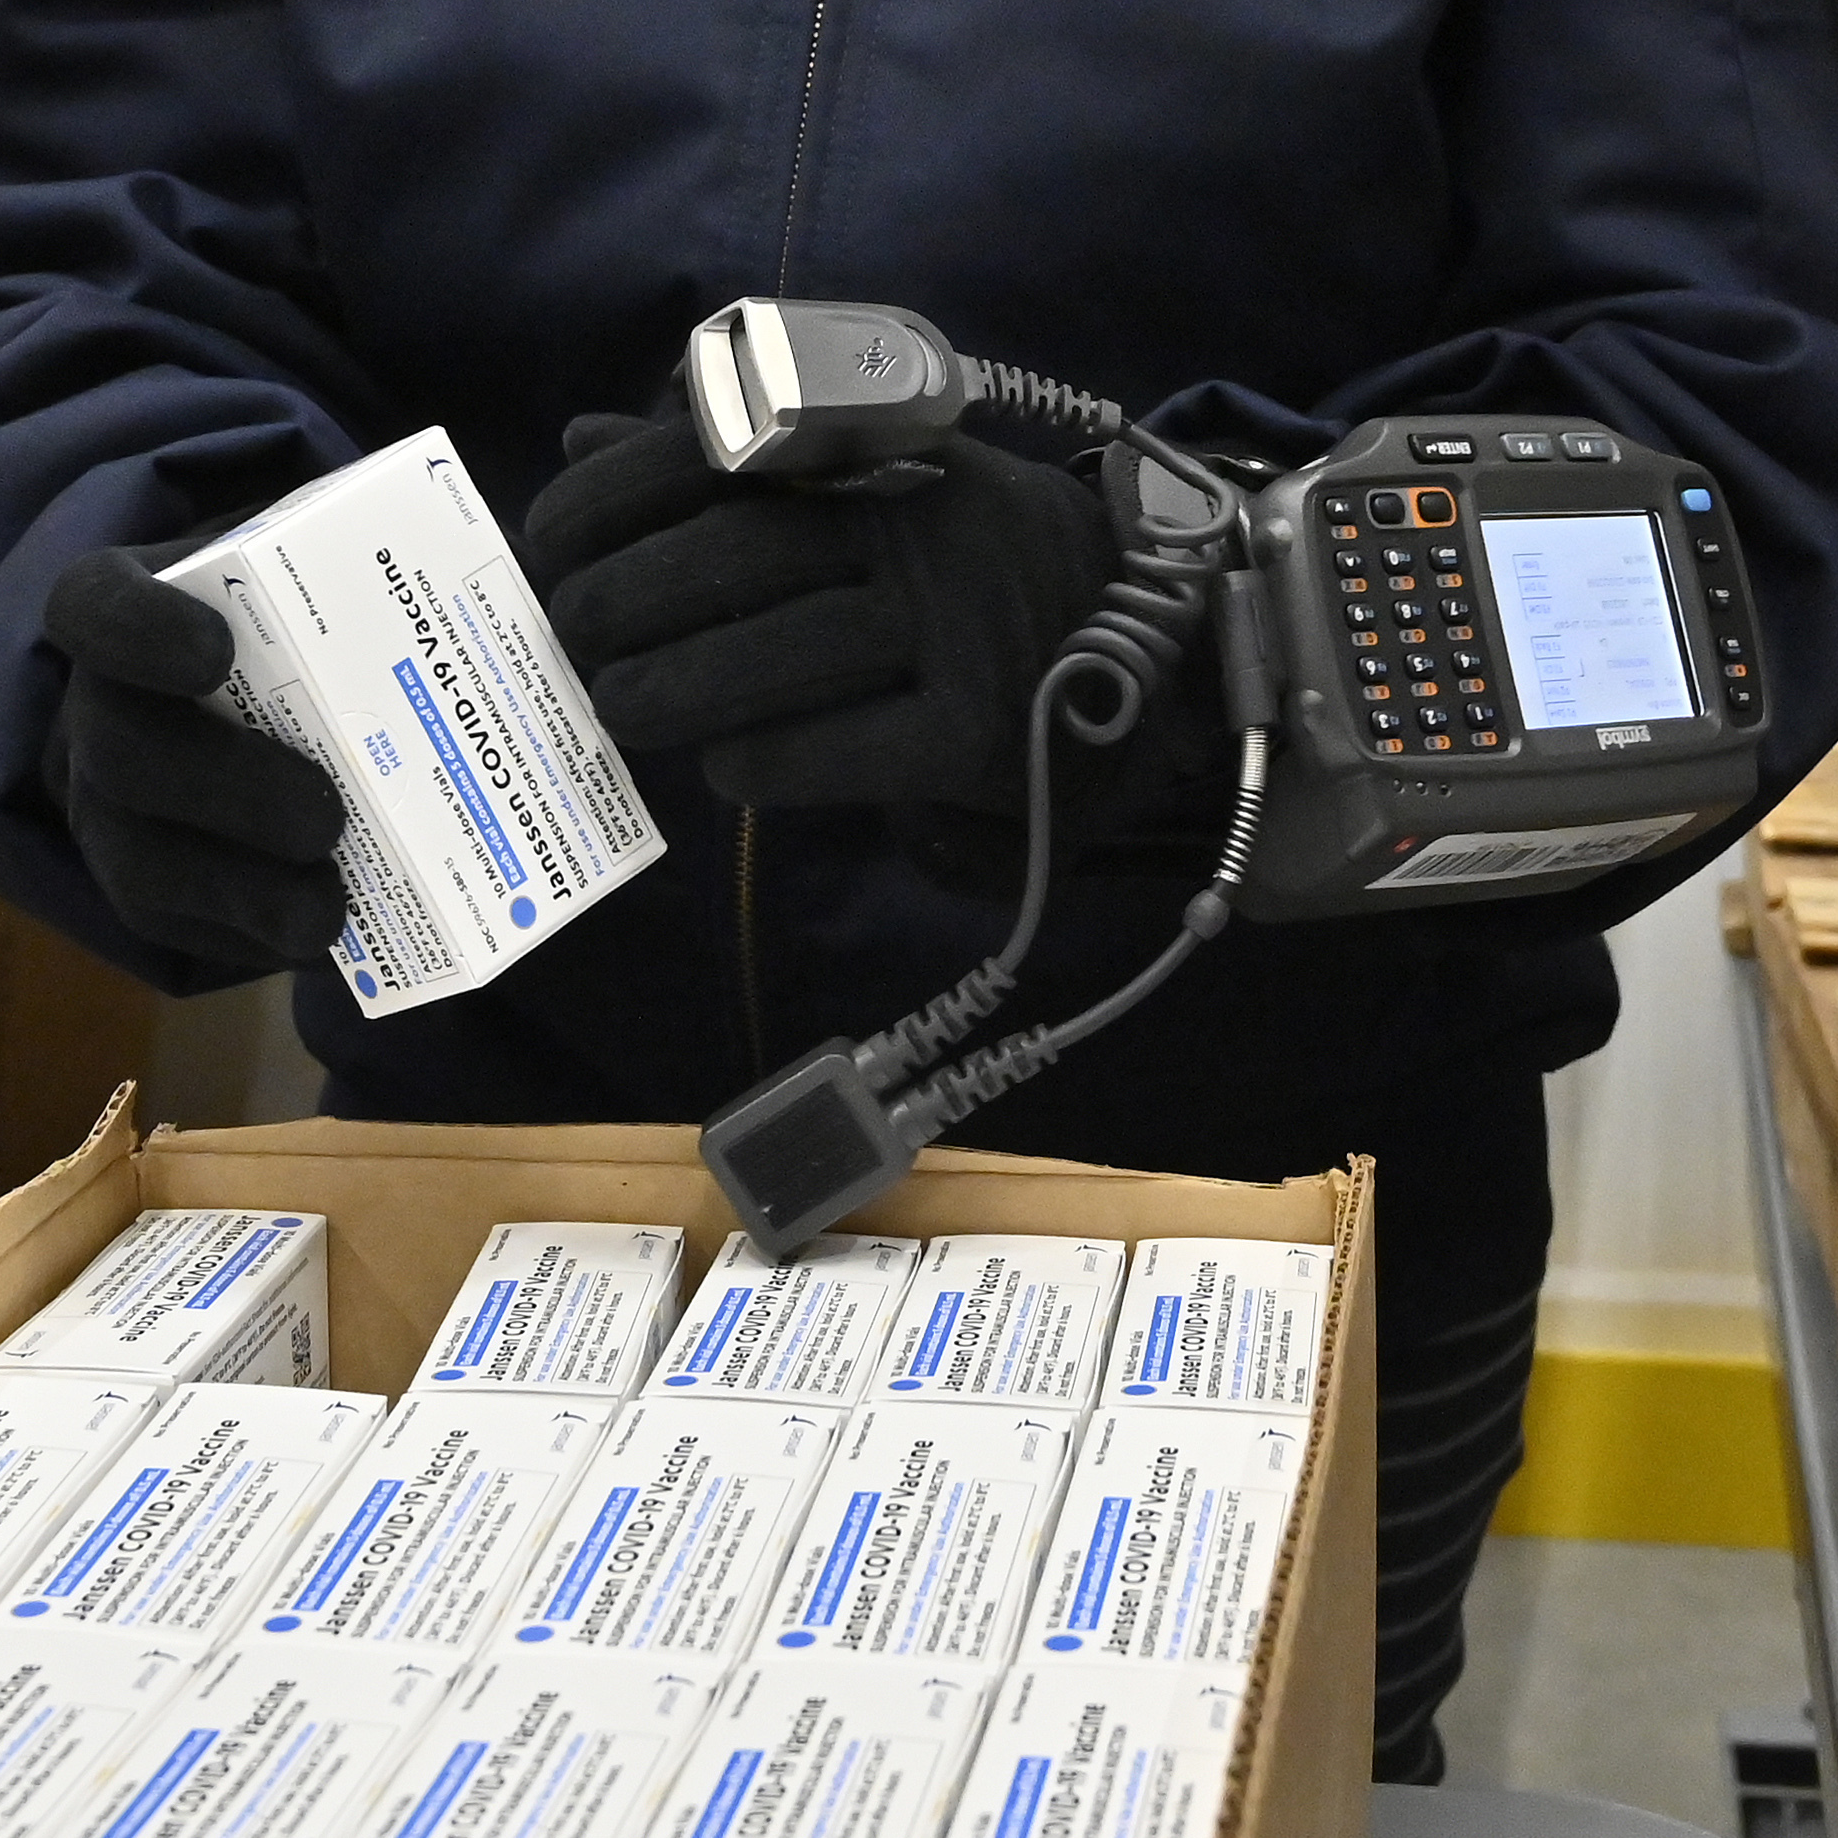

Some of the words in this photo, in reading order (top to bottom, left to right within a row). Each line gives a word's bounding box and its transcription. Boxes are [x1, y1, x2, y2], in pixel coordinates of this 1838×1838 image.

[1436, 441, 1471, 454] ENTER
[1518, 440, 1533, 454] P2
[1576, 440, 1591, 453] P1
[443, 473, 478, 524] janssen
[276, 545, 317, 615] Preservative
[376, 548, 437, 658] Vaccine
[414, 569, 459, 644] INJECTION
[485, 603, 494, 618] to
[1354, 607, 1364, 621] 9
[1401, 604, 1410, 618] 8
[1449, 601, 1458, 614] 7
[316, 617, 327, 634] No
[453, 594, 505, 683] Authorization
[511, 618, 533, 661] hours.
[505, 643, 515, 655] at
[1413, 656, 1422, 670] 5
[1460, 654, 1468, 667] 4
[400, 665, 415, 685] mL
[512, 659, 532, 689] hold
[1367, 660, 1374, 674] 6
[410, 686, 426, 706] 0.5
[503, 687, 518, 712] Use
[534, 690, 548, 717] use,
[537, 673, 557, 703] after
[420, 708, 434, 721] of
[456, 646, 525, 767] INTRAMUSCULAR
[1378, 713, 1388, 728] 3
[1427, 708, 1436, 723] 2
[1474, 706, 1482, 720] 1
[432, 722, 455, 759] doses
[433, 662, 510, 788] COVID-19
[547, 719, 564, 747] first
[553, 706, 584, 755] Discard
[1595, 726, 1650, 750] symbol
[364, 735, 389, 775] OPEN
[375, 729, 401, 768] HERE
[517, 714, 558, 786] Emergency
[451, 761, 461, 769] 5
[562, 750, 584, 782] After
[595, 746, 619, 792] freeze.
[433, 766, 453, 802] Vials
[457, 770, 490, 824] contains
[523, 769, 541, 798] FOR
[556, 789, 579, 826] under
[582, 786, 620, 852] Attention:
[604, 797, 614, 812] to
[617, 793, 632, 816] not
[453, 803, 497, 879] Multi-dose
[485, 825, 503, 850] vial
[578, 828, 592, 851] use
[631, 818, 643, 838] Do
[509, 792, 571, 899] Janssen
[538, 800, 588, 888] SUSPENSION
[500, 851, 520, 882] Each
[590, 854, 604, 875] For
[444, 857, 485, 925] 59676-580-15
[494, 882, 505, 898] 10
[481, 926, 498, 952] NDC
[209, 1215, 260, 1252] Janssen
[163, 1255, 223, 1300] COVID-19
[971, 1258, 1005, 1295] Vaccine
[1189, 1262, 1217, 1299] Vaccine
[119, 1303, 177, 1341] Vaccine
[480, 1339, 519, 1380] Janssen
[502, 1287, 543, 1335] COVID-19
[525, 1246, 563, 1284] Vaccine
[954, 1298, 990, 1346] COVID-19
[1180, 1302, 1210, 1351] COVID-19
[938, 1350, 973, 1391] Janssen
[1172, 1355, 1201, 1396] Janssen
[63, 1557, 131, 1620] Janssen
[118, 1479, 191, 1551] COVID-19
[176, 1420, 240, 1474] Vaccine
[317, 1571, 377, 1634] Janssen
[362, 1491, 427, 1564] COVID-19
[411, 1430, 468, 1486] Vaccine
